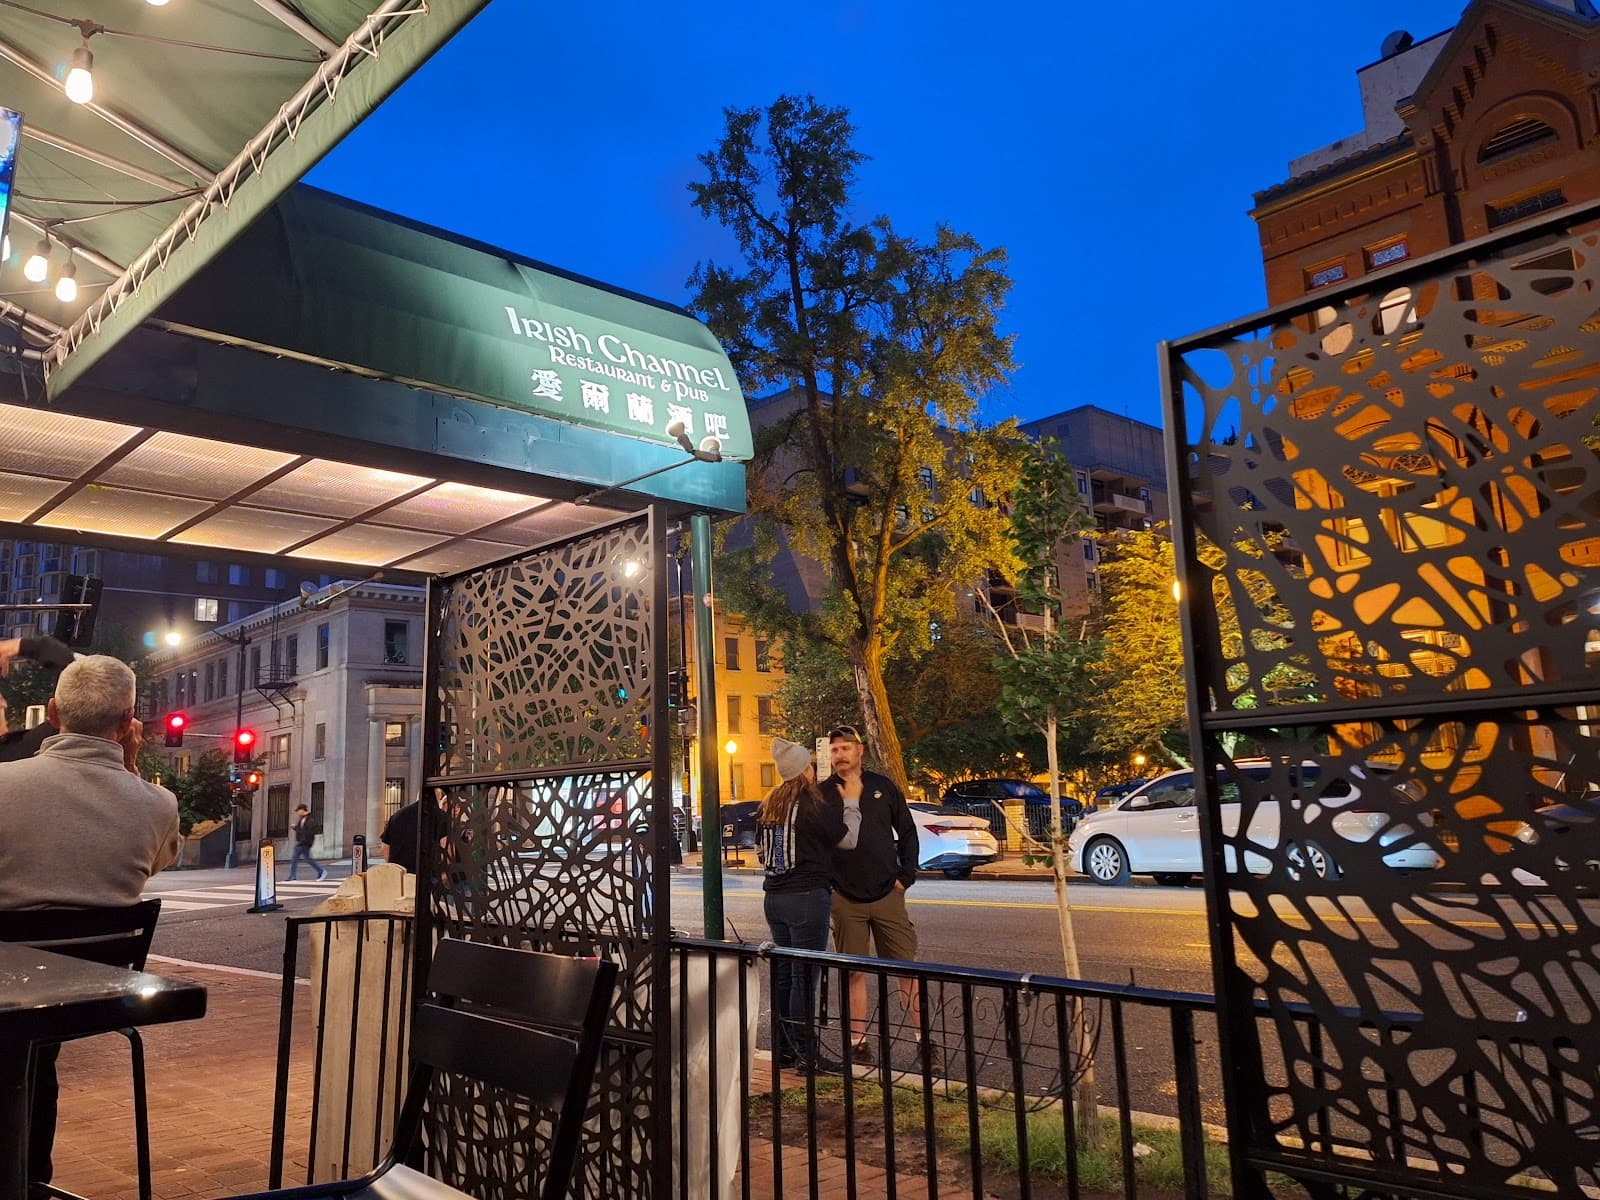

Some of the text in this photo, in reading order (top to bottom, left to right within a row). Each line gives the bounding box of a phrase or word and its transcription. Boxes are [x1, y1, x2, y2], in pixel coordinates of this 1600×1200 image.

[504, 306, 730, 391] Irish Channel
[548, 345, 709, 402] Restaurant & Pub
